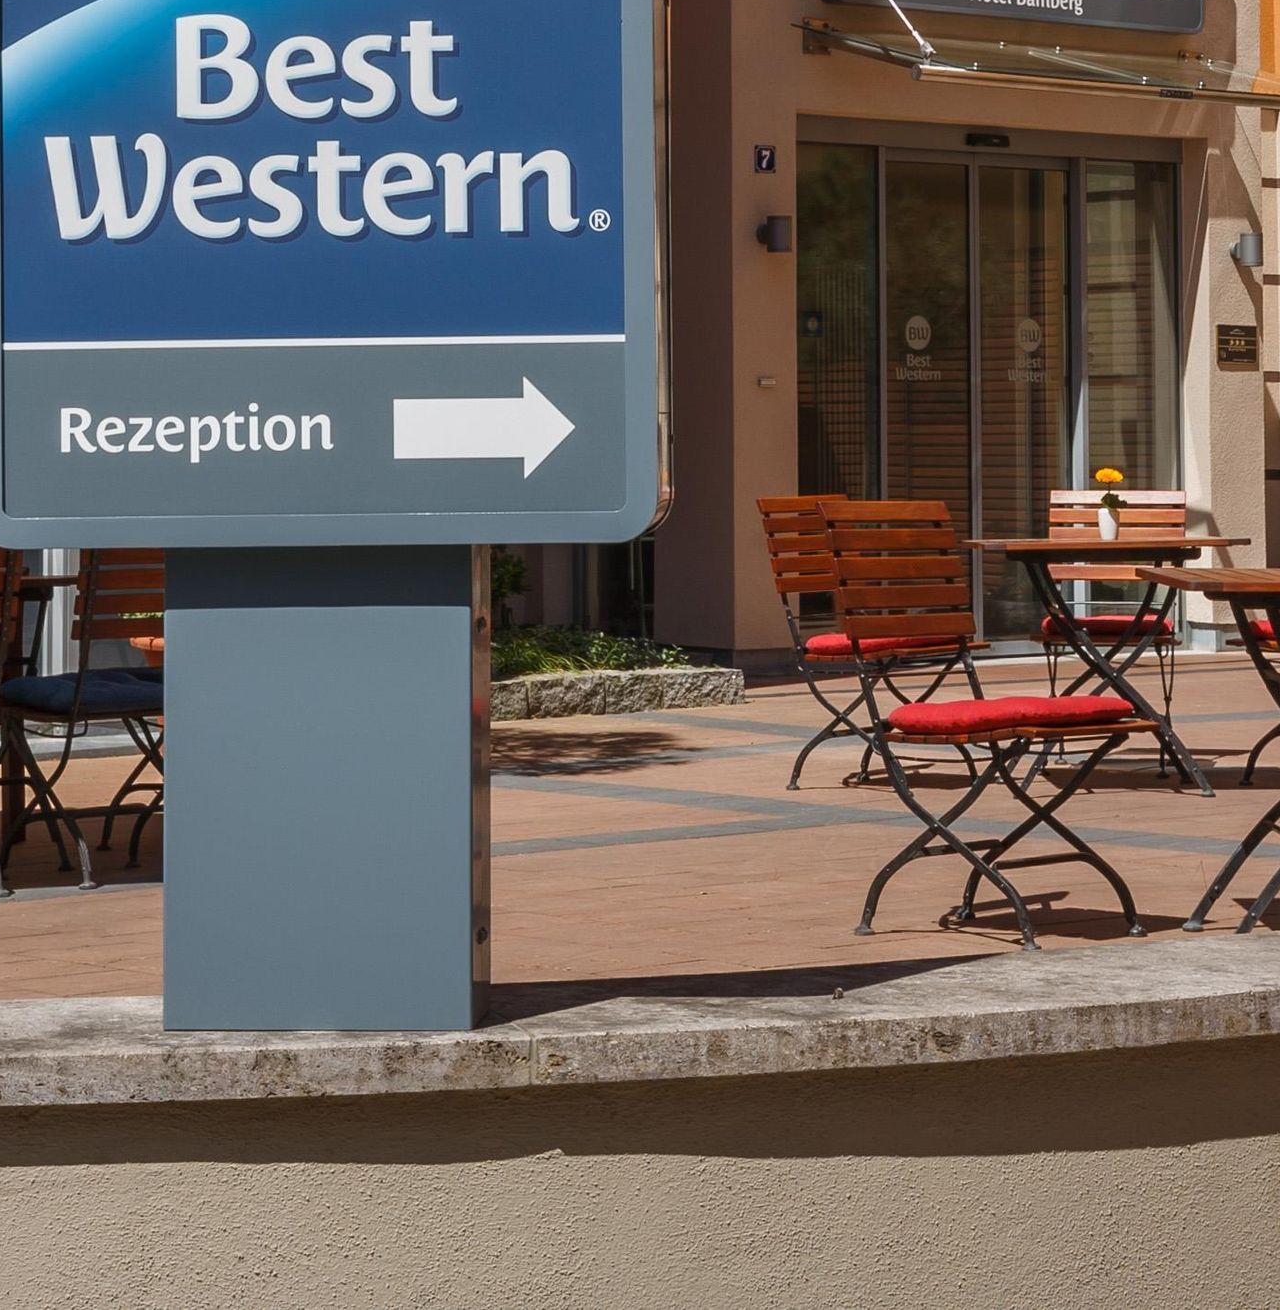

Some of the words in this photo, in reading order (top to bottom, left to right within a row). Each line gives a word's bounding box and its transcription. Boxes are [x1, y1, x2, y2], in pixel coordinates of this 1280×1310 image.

[174, 13, 459, 121] Best
[762, 150, 770, 169] 7
[908, 326, 929, 340] BW
[906, 353, 932, 368] Best
[896, 367, 941, 381] Western
[59, 402, 336, 465] Rezeption
